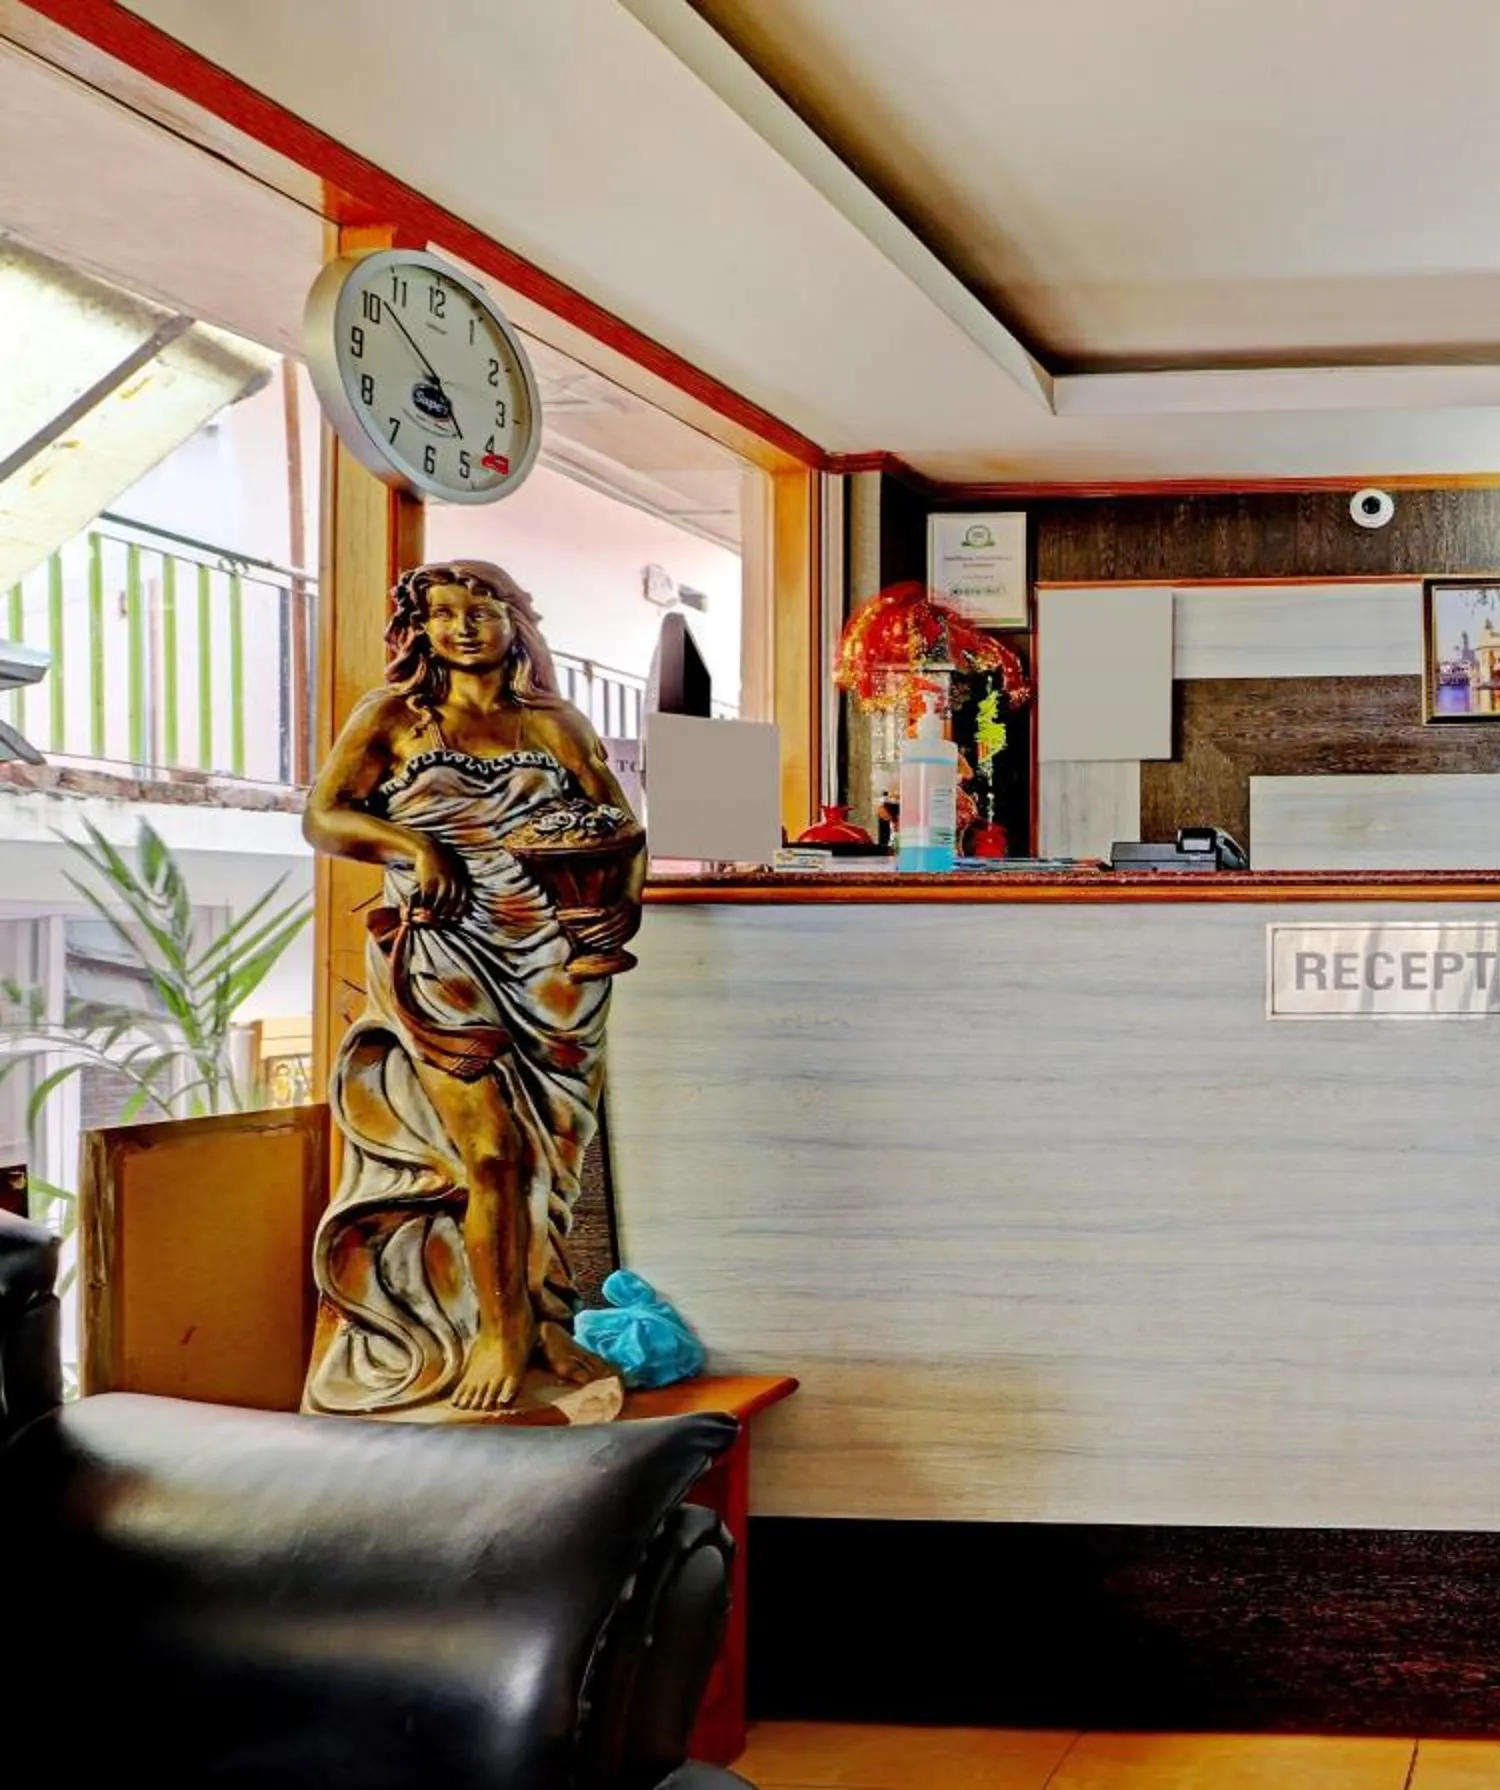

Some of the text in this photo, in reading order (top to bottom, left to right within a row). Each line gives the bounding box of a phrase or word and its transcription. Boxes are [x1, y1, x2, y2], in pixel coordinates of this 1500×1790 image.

[362, 290, 381, 324] 10
[392, 276, 408, 309] 11
[429, 286, 446, 318] 12
[351, 326, 364, 358] 9
[469, 319, 475, 345] 1
[488, 359, 499, 386] 2
[361, 374, 374, 405] 8
[495, 401, 505, 428] 3
[389, 418, 400, 444] 7
[485, 435, 495, 455] 4
[423, 445, 436, 475] 6
[459, 451, 470, 479] 5
